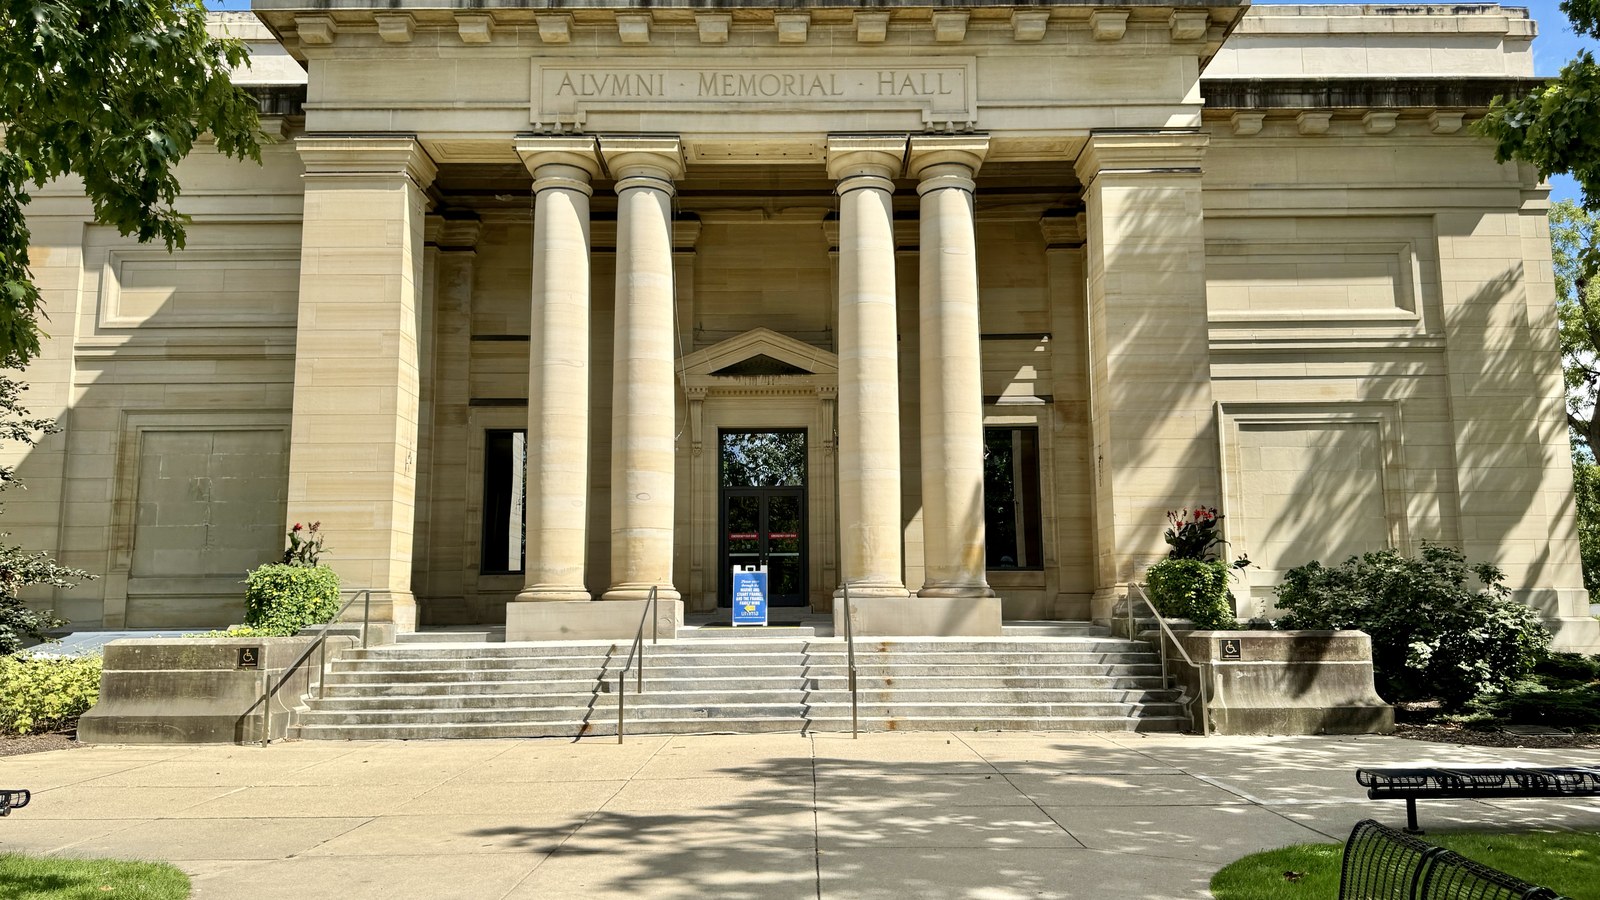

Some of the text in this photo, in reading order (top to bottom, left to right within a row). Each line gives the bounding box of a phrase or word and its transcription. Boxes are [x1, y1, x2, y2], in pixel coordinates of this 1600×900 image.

[555, 70, 953, 97] ALVMNI MEMORIAL HALL
